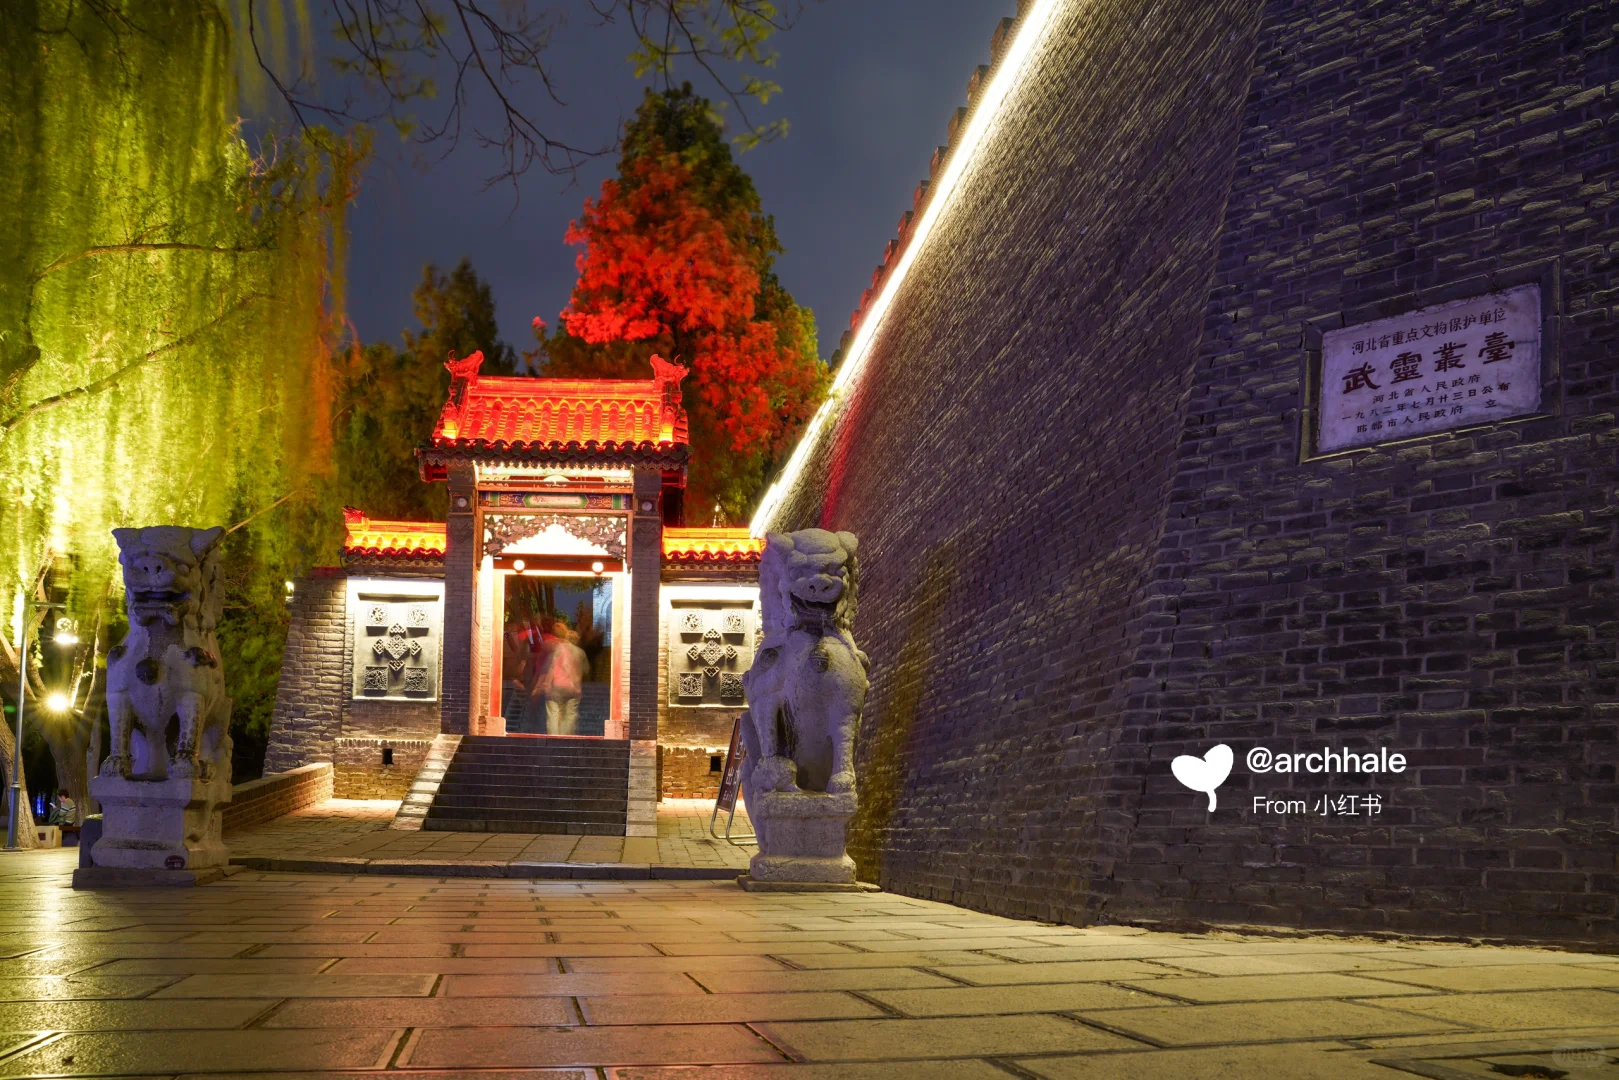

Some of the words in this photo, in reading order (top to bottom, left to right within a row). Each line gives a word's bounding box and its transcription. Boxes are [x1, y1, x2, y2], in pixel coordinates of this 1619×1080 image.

[1352, 307, 1507, 355] 河北省重点文物保护单位
[1373, 374, 1481, 404] 河北省人民政府
